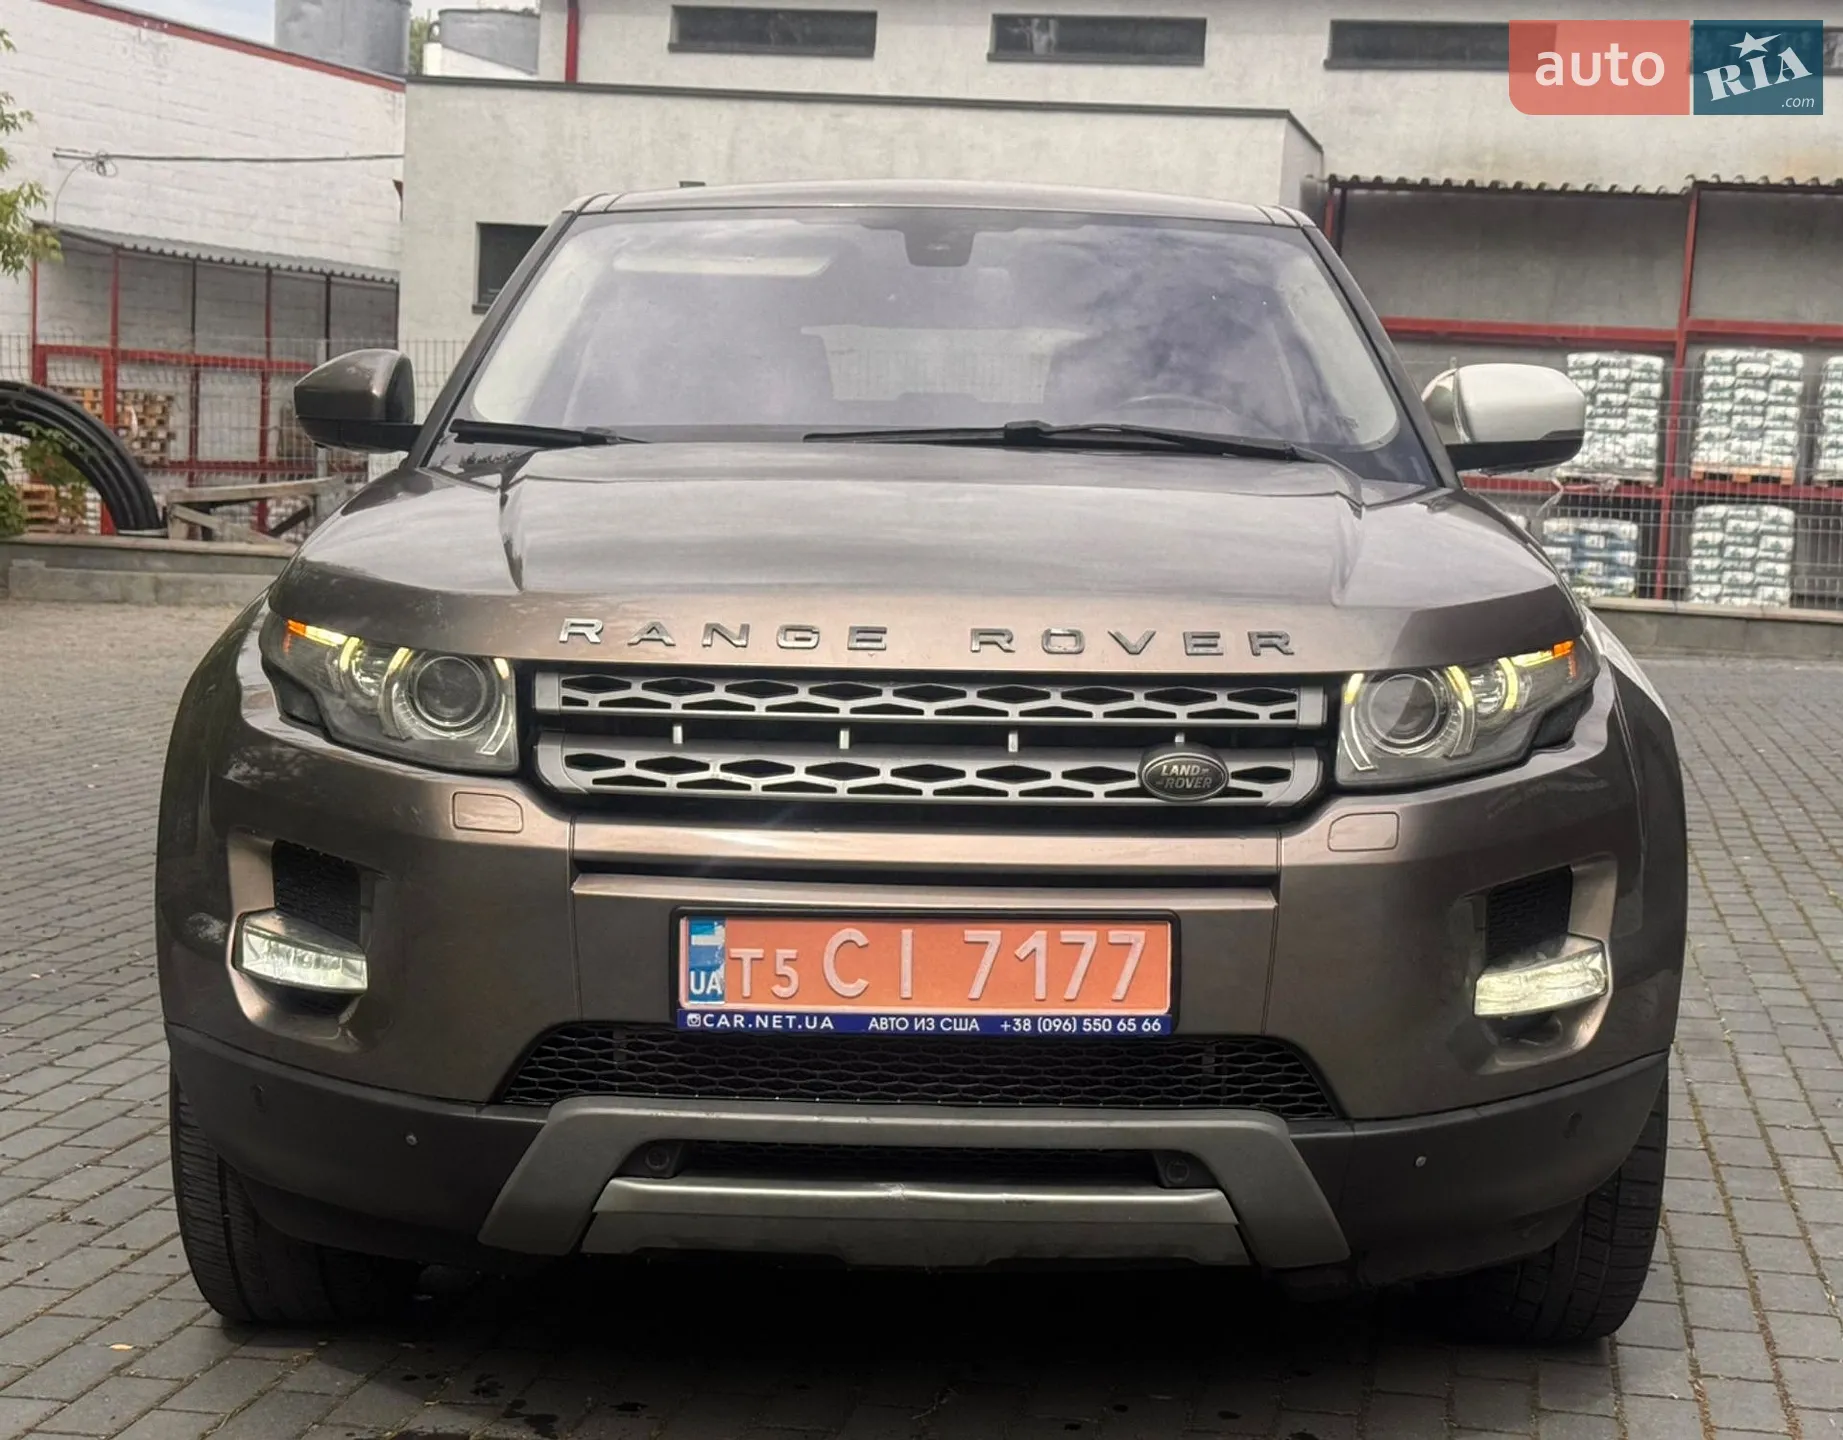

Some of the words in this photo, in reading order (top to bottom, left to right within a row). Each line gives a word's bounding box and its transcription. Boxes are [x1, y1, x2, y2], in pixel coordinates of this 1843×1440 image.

[559, 617, 887, 651] RANGE
[970, 627, 1295, 657] ROVER
[1160, 764, 1200, 777] LAND
[1163, 777, 1213, 790] ROVER
[729, 948, 799, 998] T5
[963, 929, 1147, 1001] 7177
[690, 970, 723, 995] UA
[702, 1013, 834, 1030] CAR.NET.UA
[868, 1016, 909, 1031] АВТО
[914, 1017, 935, 1031] ИЗ
[940, 1017, 980, 1031] США
[1000, 1018, 1032, 1032] +38
[1037, 1018, 1077, 1033] (096)
[1082, 1018, 1112, 1032] 550
[1116, 1018, 1137, 1032] 65
[1141, 1018, 1162, 1032] 66
